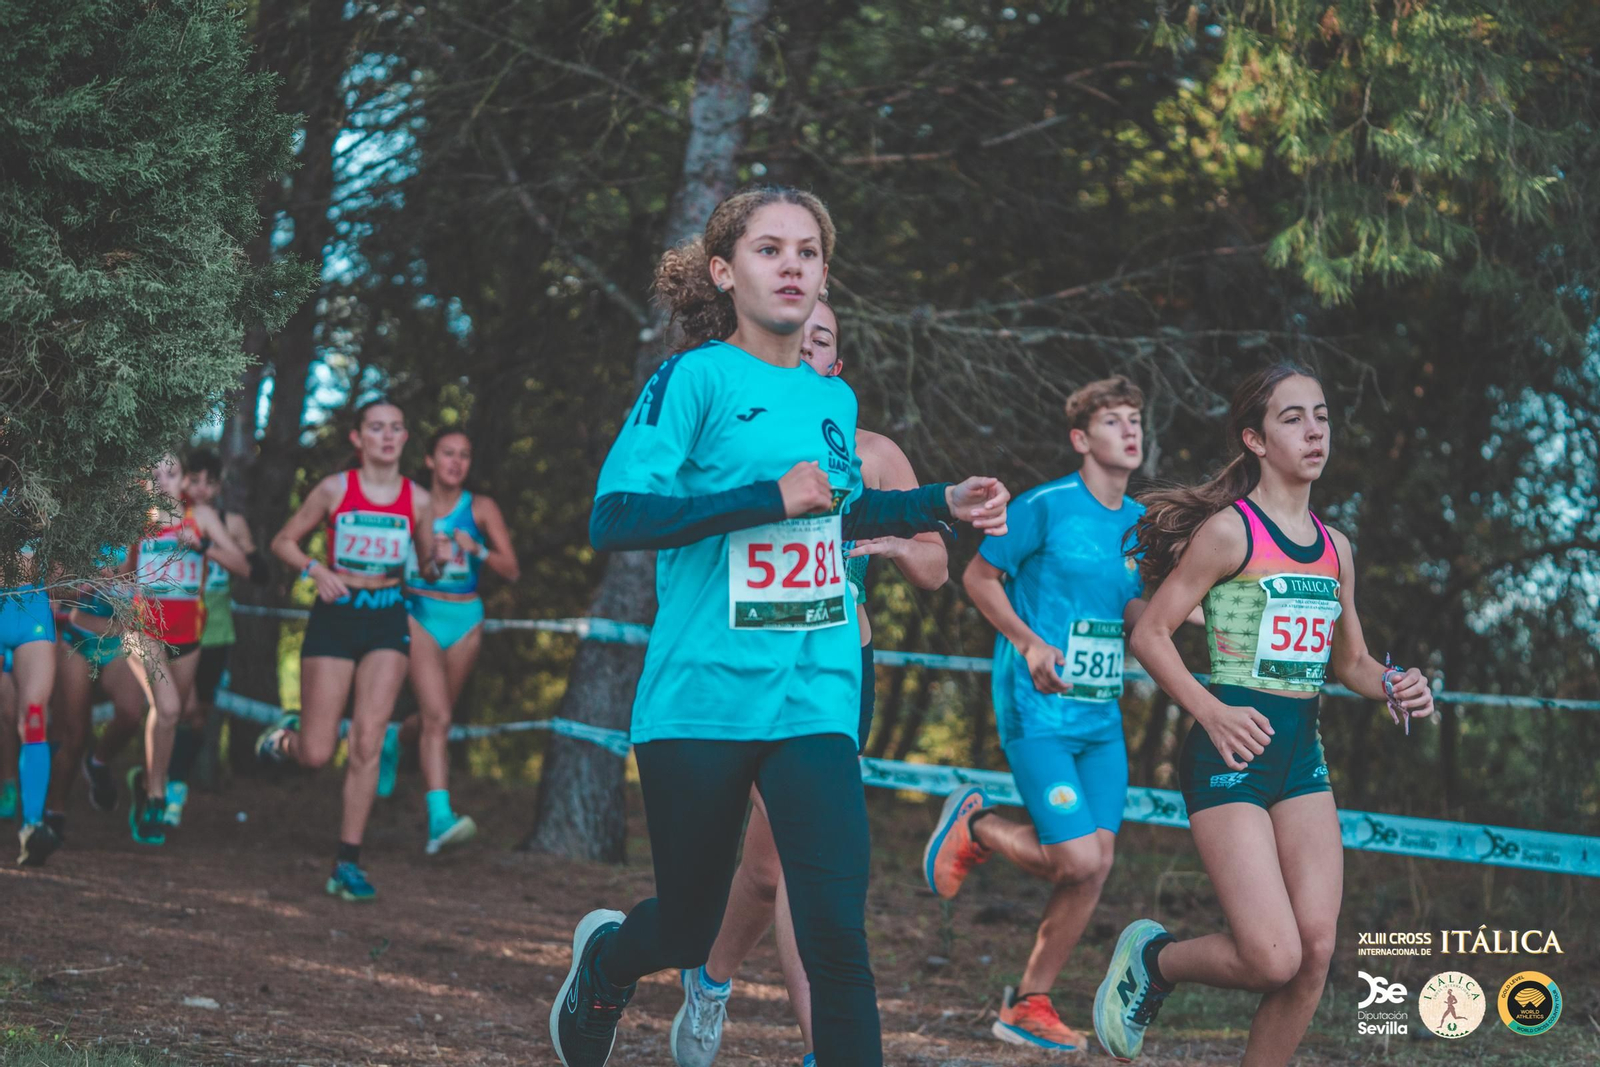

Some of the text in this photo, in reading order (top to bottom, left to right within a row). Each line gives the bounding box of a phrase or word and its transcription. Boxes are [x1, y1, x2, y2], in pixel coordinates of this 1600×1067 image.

[343, 533, 401, 558] 7251
[746, 539, 841, 589] 5281
[1291, 578, 1329, 593] ITÁLICA
